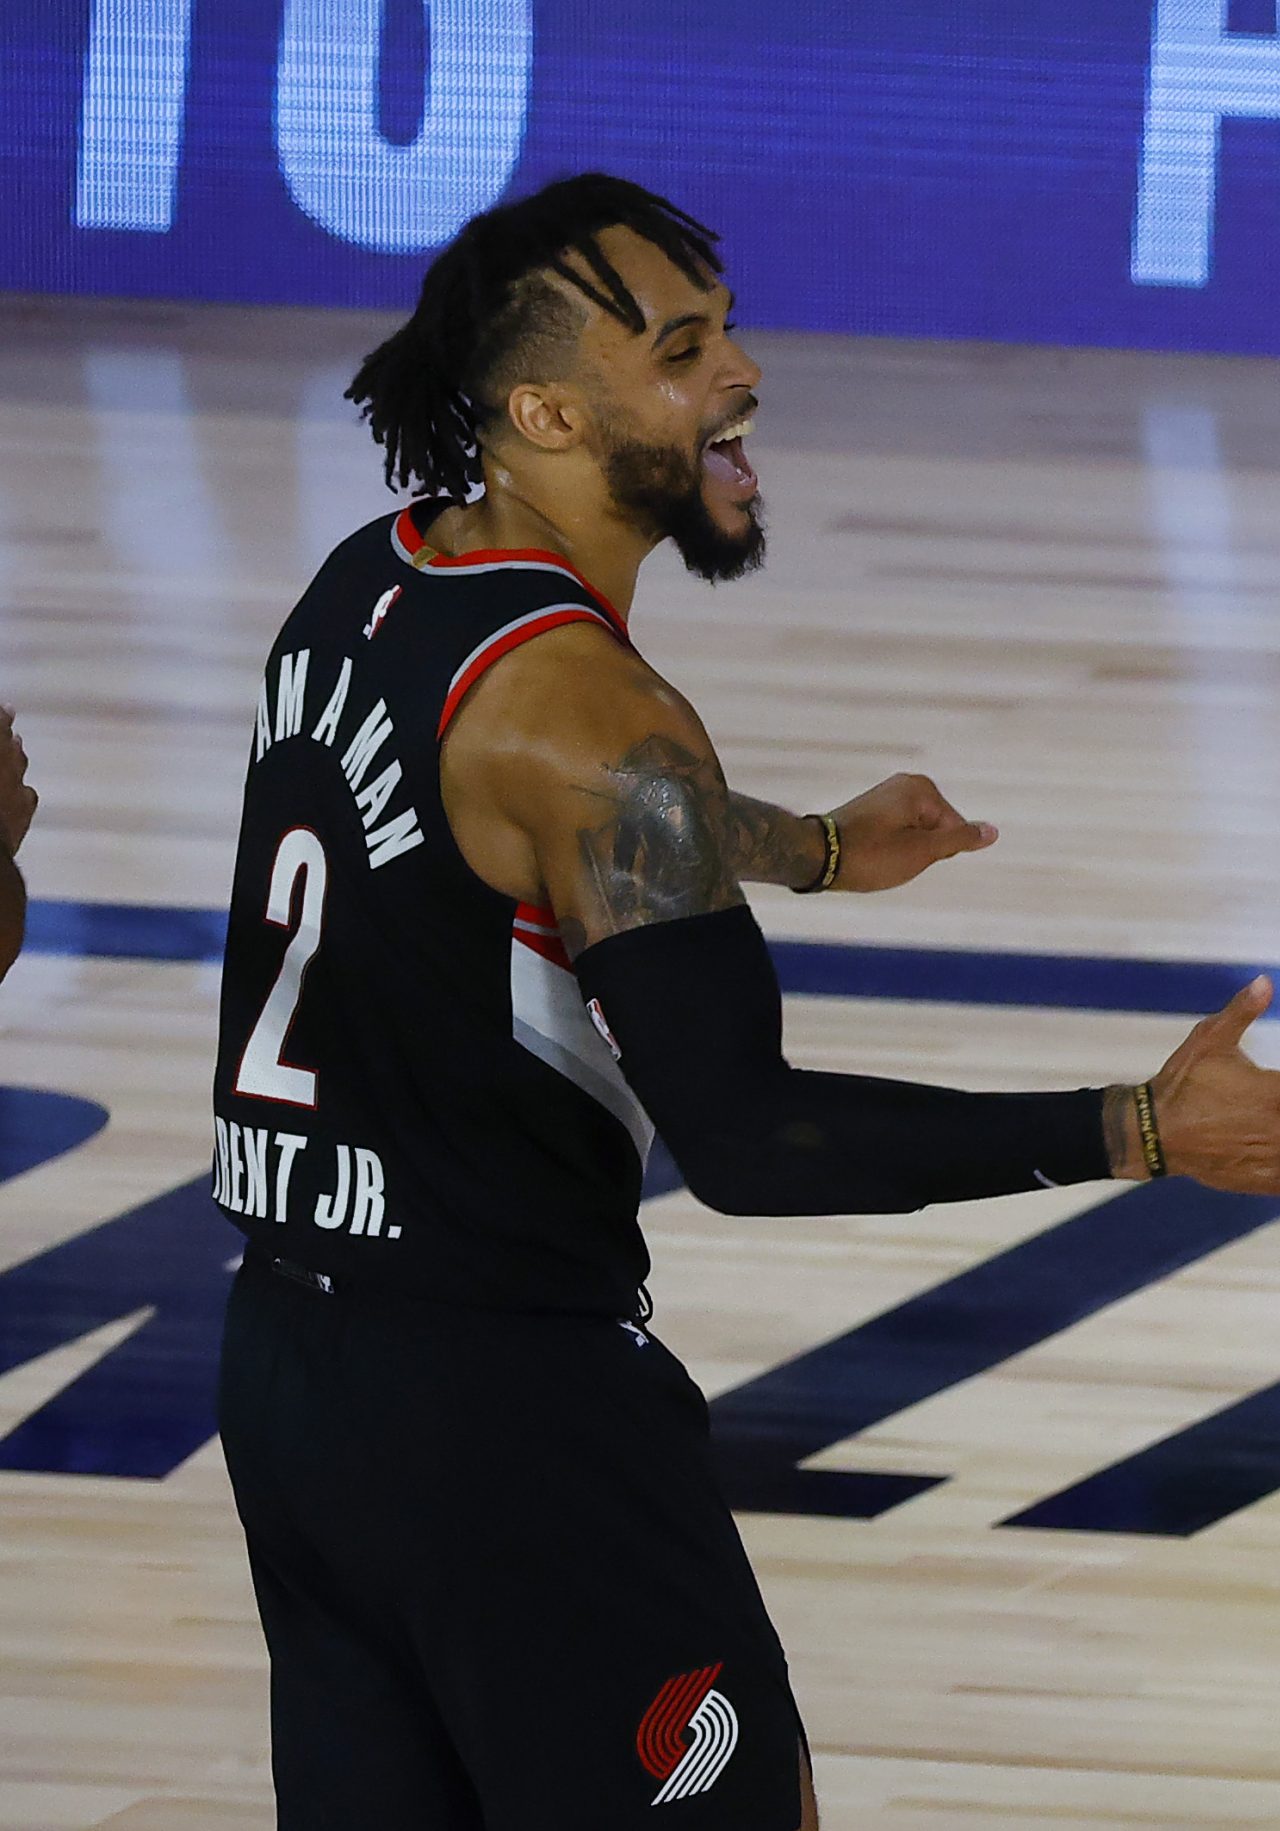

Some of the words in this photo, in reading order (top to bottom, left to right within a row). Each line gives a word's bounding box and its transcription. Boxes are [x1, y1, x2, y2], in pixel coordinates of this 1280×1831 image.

[311, 657, 352, 747] A
[340, 697, 425, 870] MAN
[234, 825, 327, 1110] 2
[314, 1144, 402, 1239] JR.
